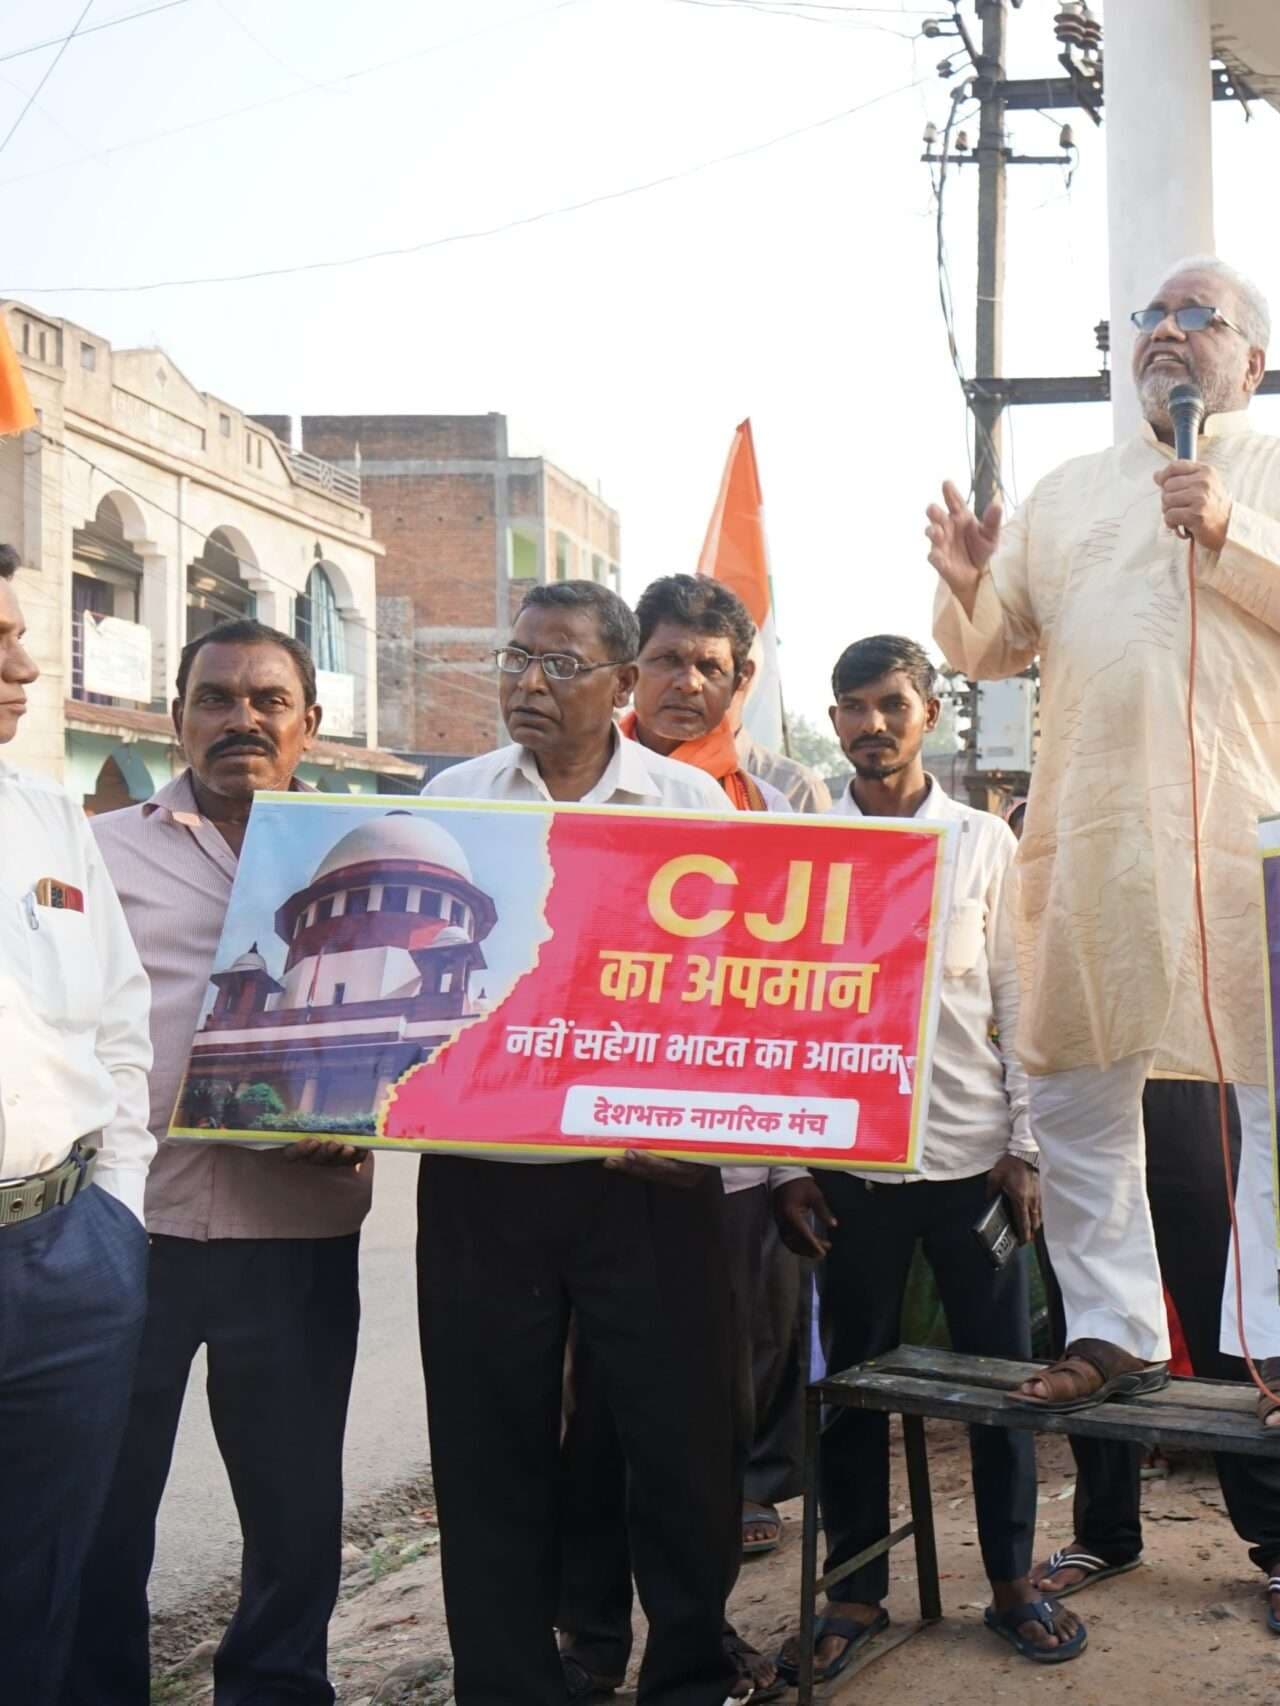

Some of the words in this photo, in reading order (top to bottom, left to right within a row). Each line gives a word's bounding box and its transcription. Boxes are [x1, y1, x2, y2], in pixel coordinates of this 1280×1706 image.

[647, 853, 853, 944] CJI
[599, 949, 673, 1002] का
[683, 953, 880, 1013] अपमान
[506, 1017, 575, 1058] नहीं
[573, 1020, 661, 1063] सहेगा
[665, 1033, 751, 1068] भारत
[754, 1038, 798, 1070] का
[593, 1096, 685, 1127] देशभक्त
[691, 1105, 782, 1133] नागरिक
[788, 1108, 828, 1135] मंच
